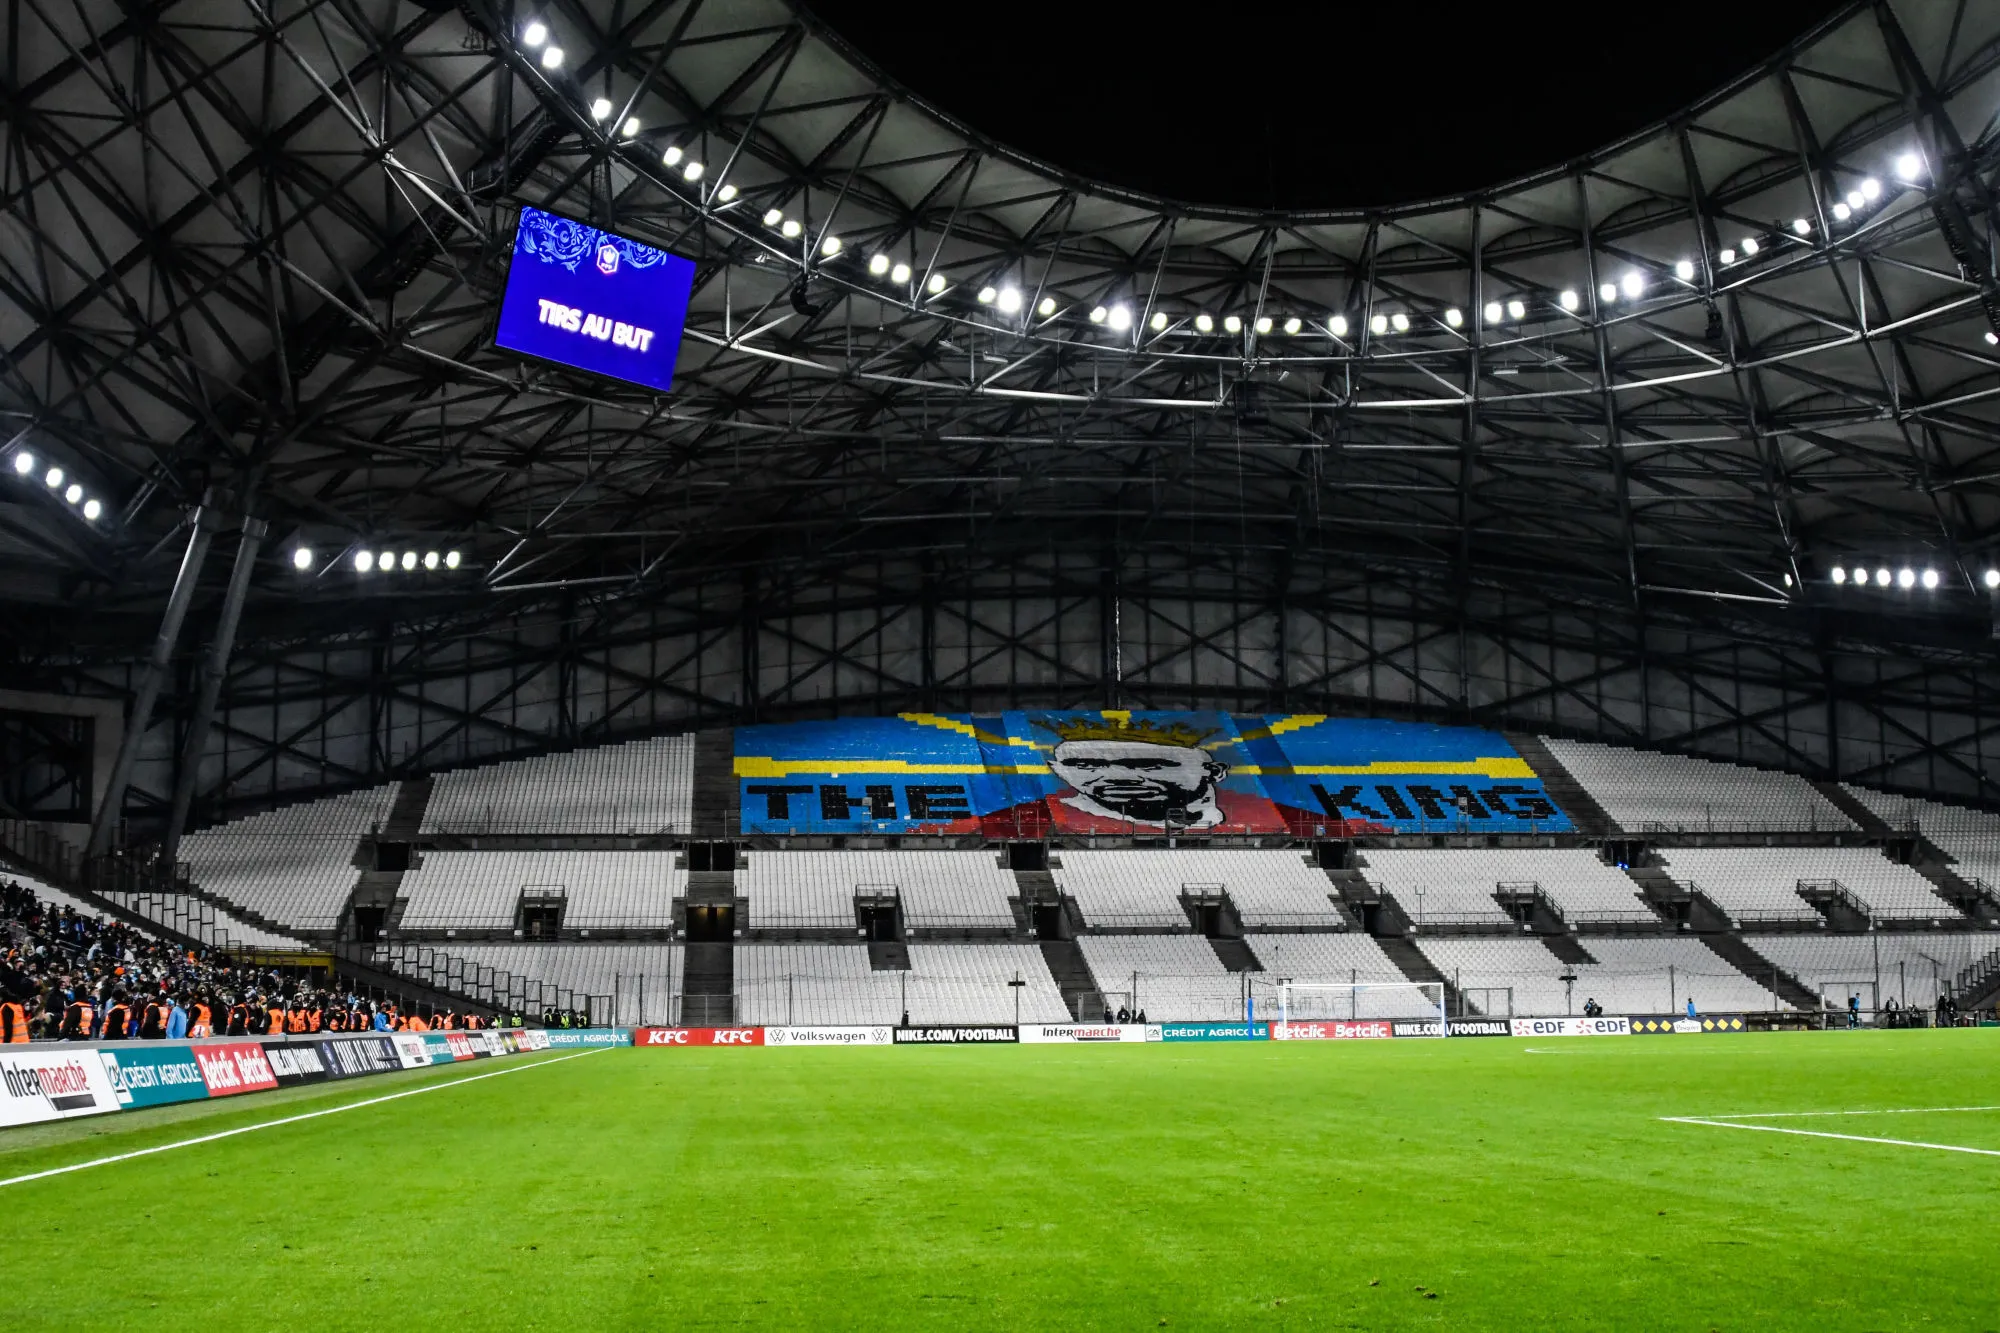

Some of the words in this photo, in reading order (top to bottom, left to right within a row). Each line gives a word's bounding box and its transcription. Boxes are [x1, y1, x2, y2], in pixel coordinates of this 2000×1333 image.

[538, 298, 582, 332] TIRS
[581, 313, 612, 341] AU
[612, 321, 654, 352] BUT
[747, 785, 971, 819] THE
[1310, 784, 1558, 819] KING
[647, 1030, 688, 1044] KFC
[712, 1030, 753, 1044] KFC
[791, 1031, 866, 1043] Volkswagen
[896, 1028, 1015, 1042] NIKE.COM/FOOTBALL
[1163, 1028, 1205, 1037] CRÉDIT
[1274, 1024, 1326, 1038] Betclic
[1335, 1024, 1388, 1037] Betclic
[548, 1033, 580, 1043] CRÉDIT
[583, 1034, 628, 1042] AGRICOLE
[199, 1050, 241, 1089] Betclic
[234, 1048, 274, 1085] Betclic
[123, 1061, 160, 1089] CRÉDIT
[158, 1062, 202, 1086] AGRICOLE
